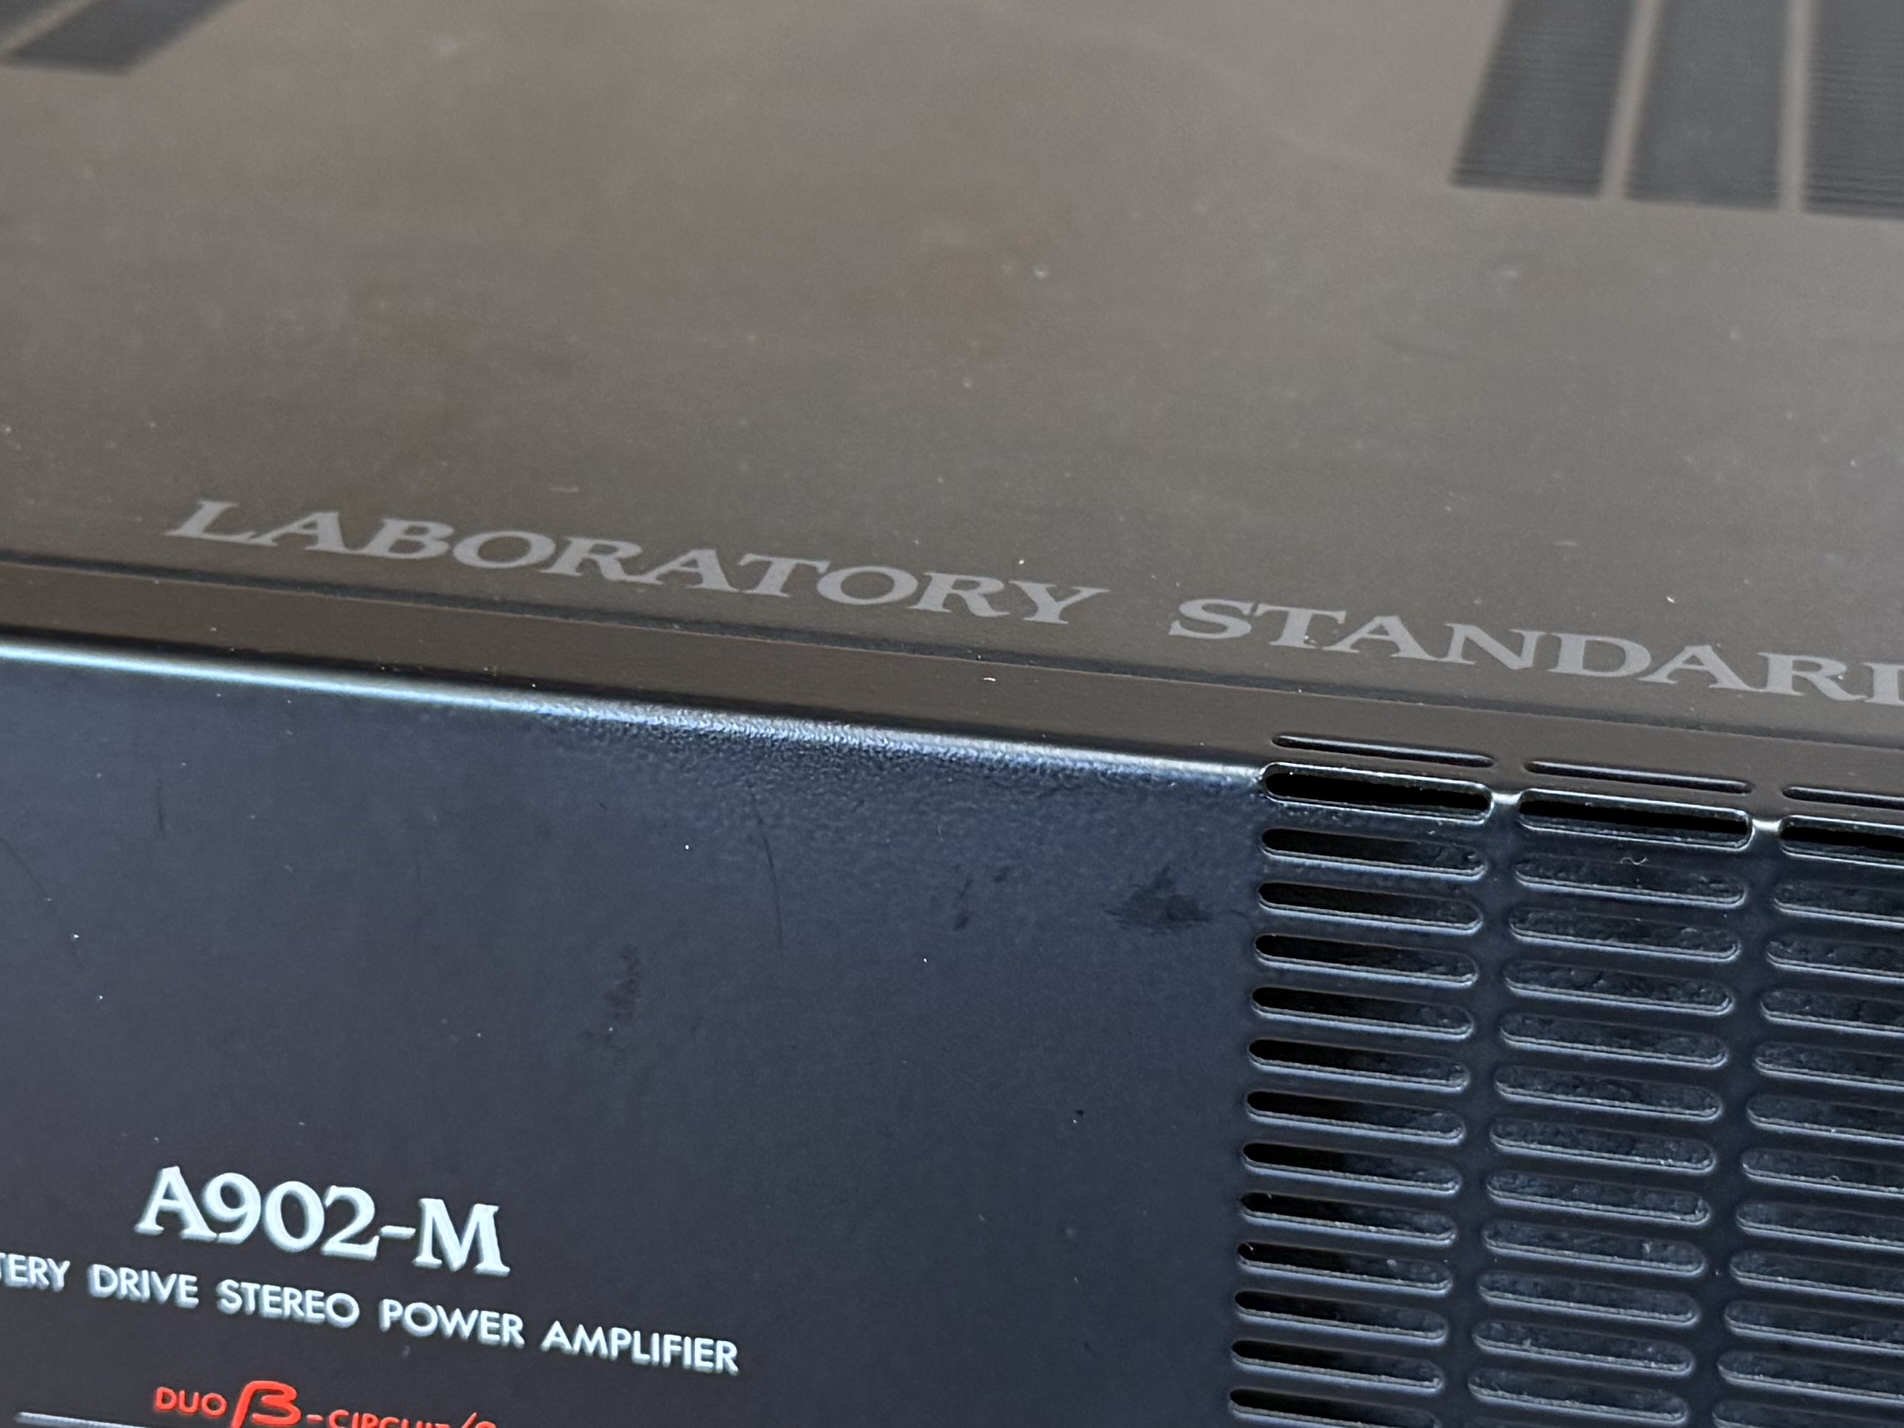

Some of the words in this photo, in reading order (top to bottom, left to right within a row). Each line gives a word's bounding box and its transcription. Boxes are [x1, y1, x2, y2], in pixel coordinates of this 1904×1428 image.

[165, 499, 1108, 627] LABORATORY
[134, 1164, 512, 1276] A902-M
[88, 1263, 200, 1309] DRIVE
[216, 1278, 361, 1329] STEREO
[379, 1297, 525, 1348] POWER
[540, 1320, 740, 1375] AMPLIFIER
[153, 1386, 227, 1418] DUO
